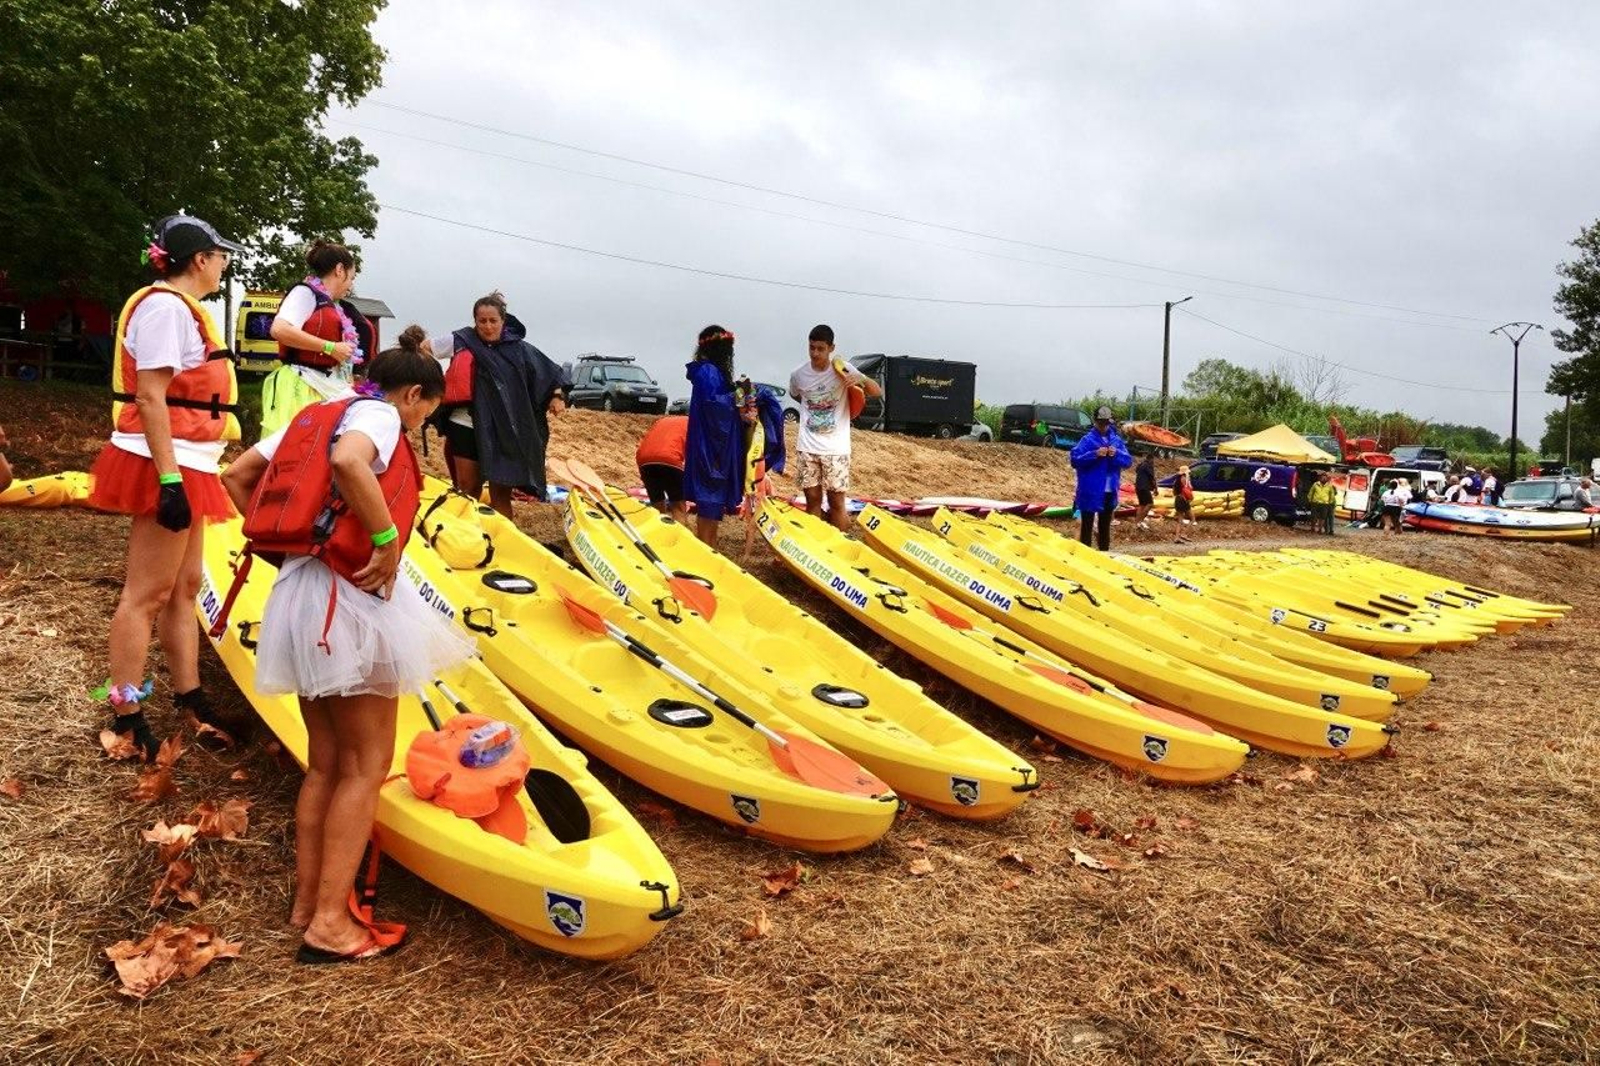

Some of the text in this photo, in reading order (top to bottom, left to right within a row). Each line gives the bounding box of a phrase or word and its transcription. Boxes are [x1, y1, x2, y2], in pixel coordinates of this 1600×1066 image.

[254, 301, 279, 310] AMBU
[866, 515, 880, 530] 18
[939, 521, 951, 535] 21
[806, 559, 834, 583] LAZER
[830, 576, 846, 592] DO
[845, 586, 868, 608] LIMA
[939, 562, 970, 586] LAZER
[969, 580, 985, 595] DO
[985, 589, 1011, 611] LIMA
[1026, 576, 1041, 590] DO
[1040, 584, 1064, 602] LIMA
[419, 581, 434, 603] DO
[431, 595, 455, 620] LIMA
[1308, 620, 1327, 632] 23
